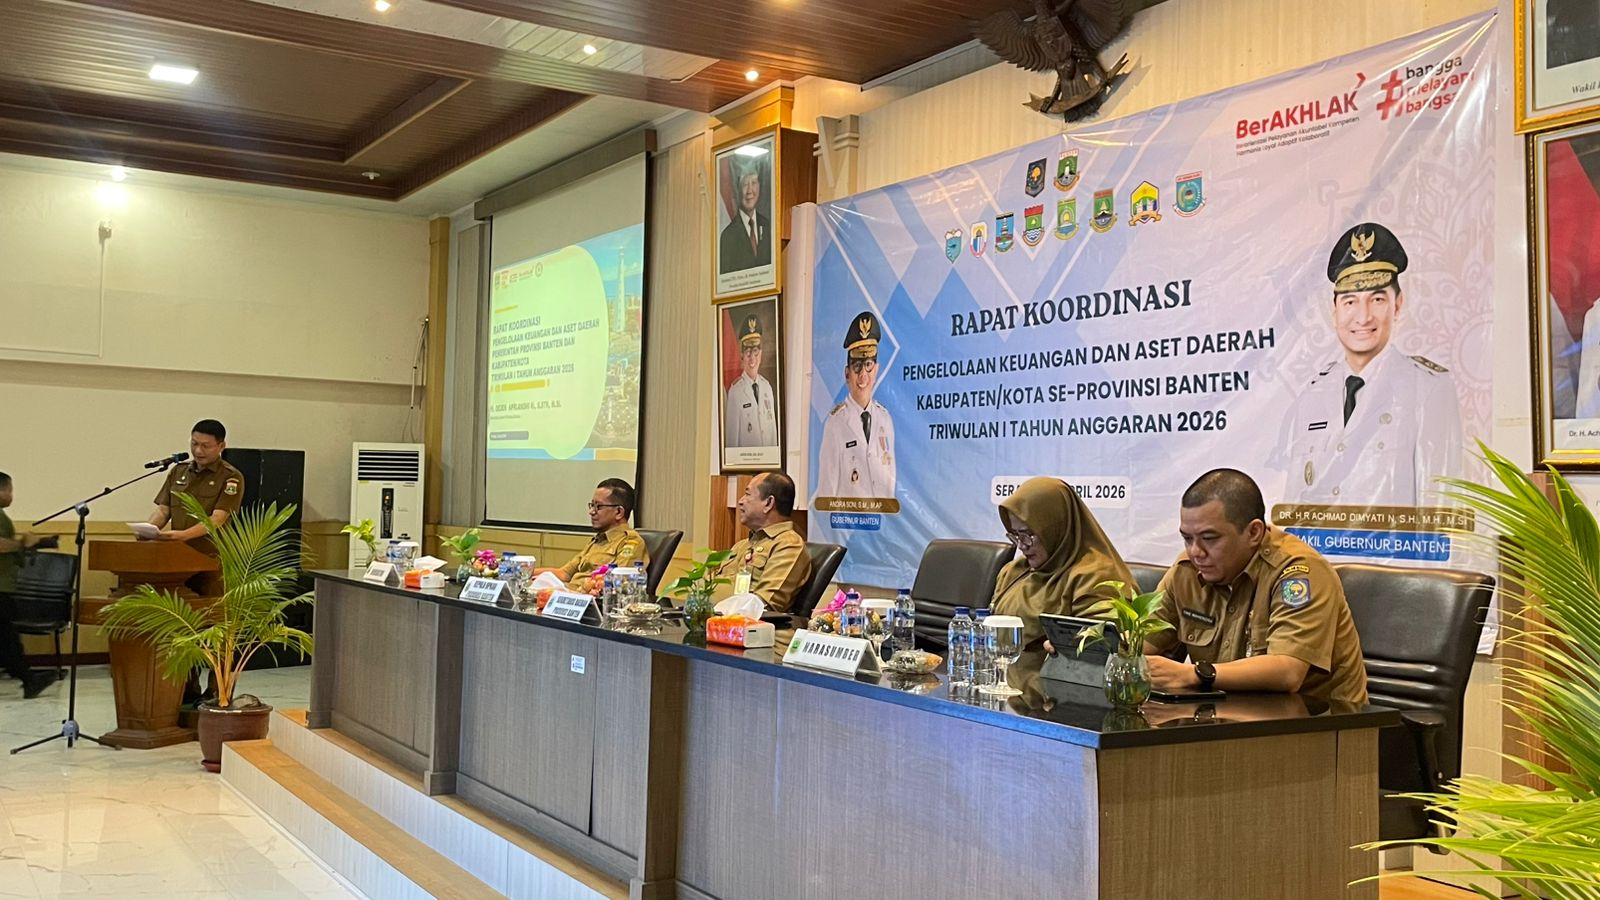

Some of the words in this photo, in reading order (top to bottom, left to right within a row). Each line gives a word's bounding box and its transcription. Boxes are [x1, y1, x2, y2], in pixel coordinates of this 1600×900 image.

[1572, 81, 1596, 94] Wakil
[1236, 90, 1359, 139] BerAKHLAK
[1267, 130, 1297, 142] Pelayanan
[951, 304, 1018, 337] RAPAT
[1022, 279, 1193, 328] KOORDINASI
[508, 316, 541, 331] KOORDINASI
[551, 326, 562, 336] DAN
[563, 323, 577, 333] ASET
[903, 357, 996, 381] PENGELOLAAN
[1000, 347, 1087, 373] KEUANGAN
[1092, 343, 1130, 364] DAN
[1134, 337, 1182, 361] ASET
[1187, 327, 1275, 356] DAERAH
[917, 384, 1045, 411] KABUPATEN/KOTA
[1048, 377, 1161, 403] SE-PROVINSI
[1165, 370, 1249, 395] BANTEN
[929, 421, 999, 440] TRIWULAN
[1002, 421, 1006, 437] I
[1010, 418, 1064, 438] TAHUN
[1068, 413, 1172, 435] ANGGARAN
[1177, 410, 1227, 432] 2026
[1095, 484, 1126, 499] 2026
[832, 515, 859, 525] GUBERNUR
[859, 517, 880, 526] BANTEN
[1312, 512, 1347, 522] ACHMAD
[1349, 513, 1385, 523] DIMYATI
[1297, 535, 1322, 548] AKIL
[1325, 536, 1391, 551] GUBERNUR
[1394, 539, 1446, 553] BANTEN
[803, 641, 860, 662] NARASUMBER
